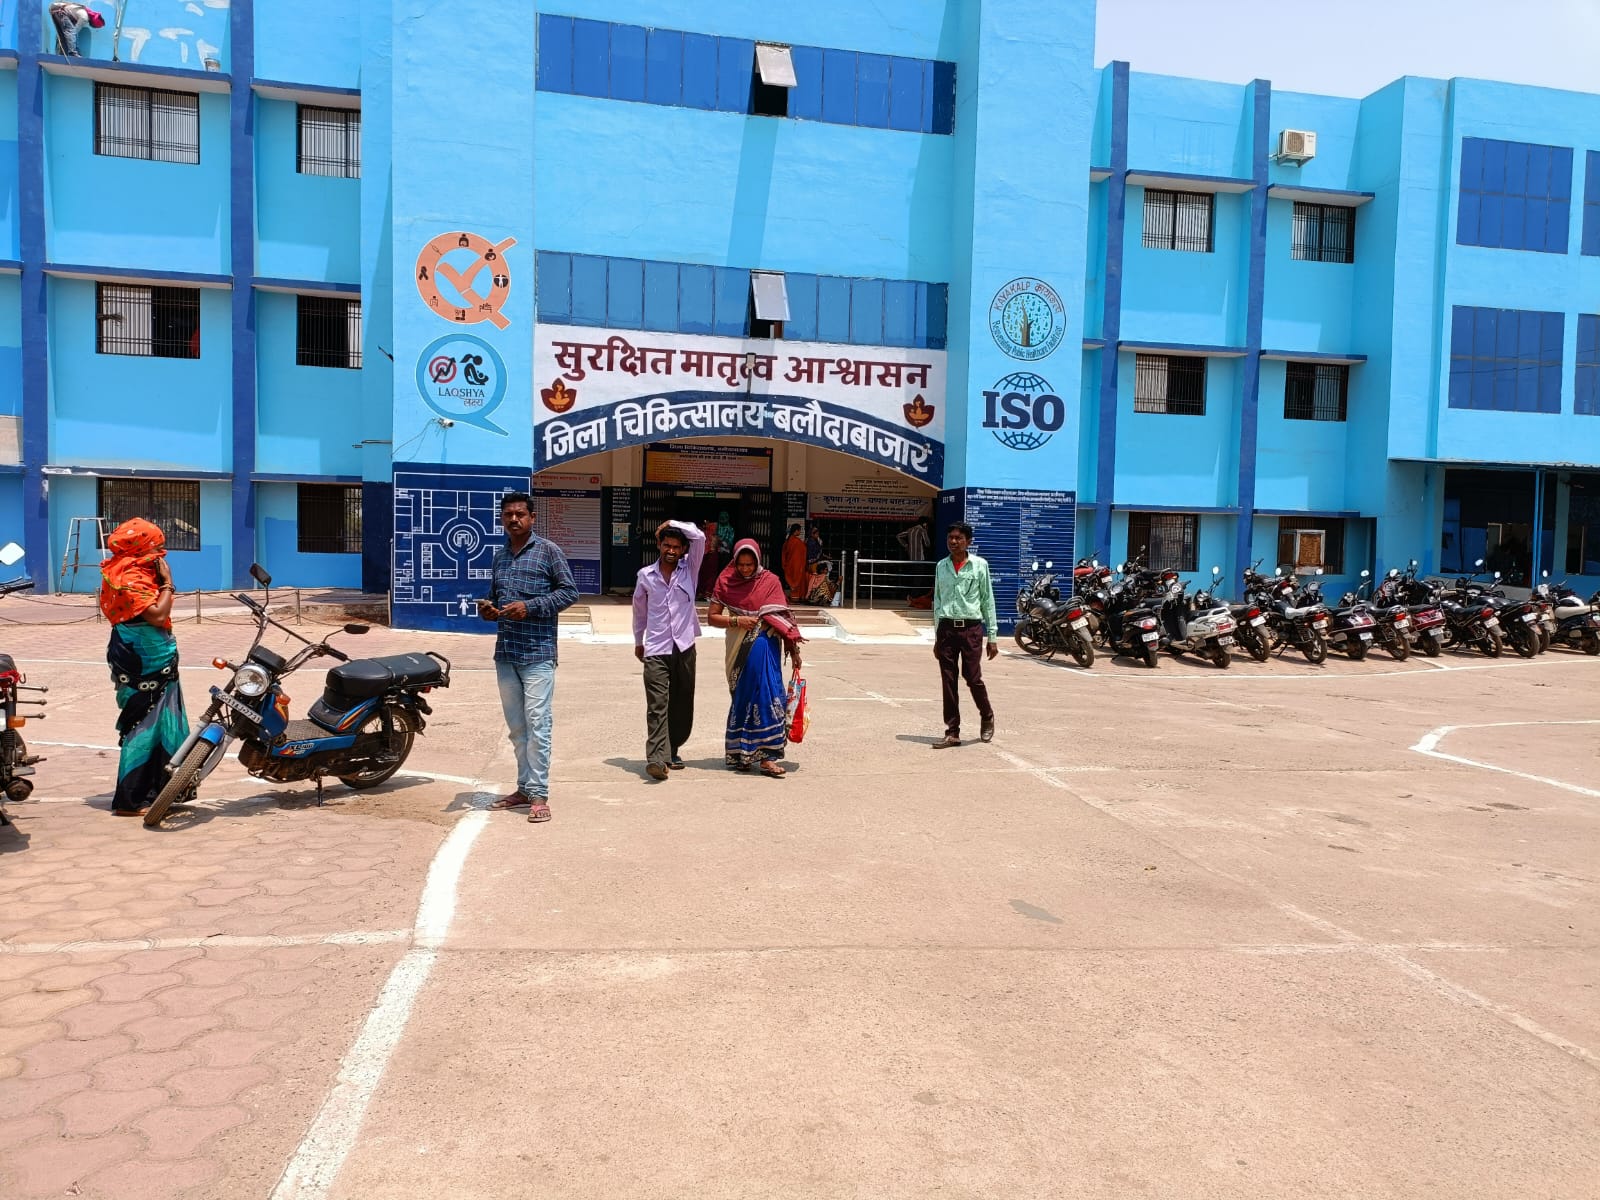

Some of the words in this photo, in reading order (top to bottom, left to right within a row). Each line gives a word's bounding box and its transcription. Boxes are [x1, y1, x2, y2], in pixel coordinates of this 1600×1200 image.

[993, 281, 1031, 311] KAYAKALP
[551, 335, 677, 382] सुरक्षित
[680, 349, 778, 387] मातृत्व
[783, 356, 932, 389] आश्वासन
[438, 386, 485, 399] LAQSHYA
[982, 391, 1065, 432] ISO
[542, 415, 608, 461] जिला
